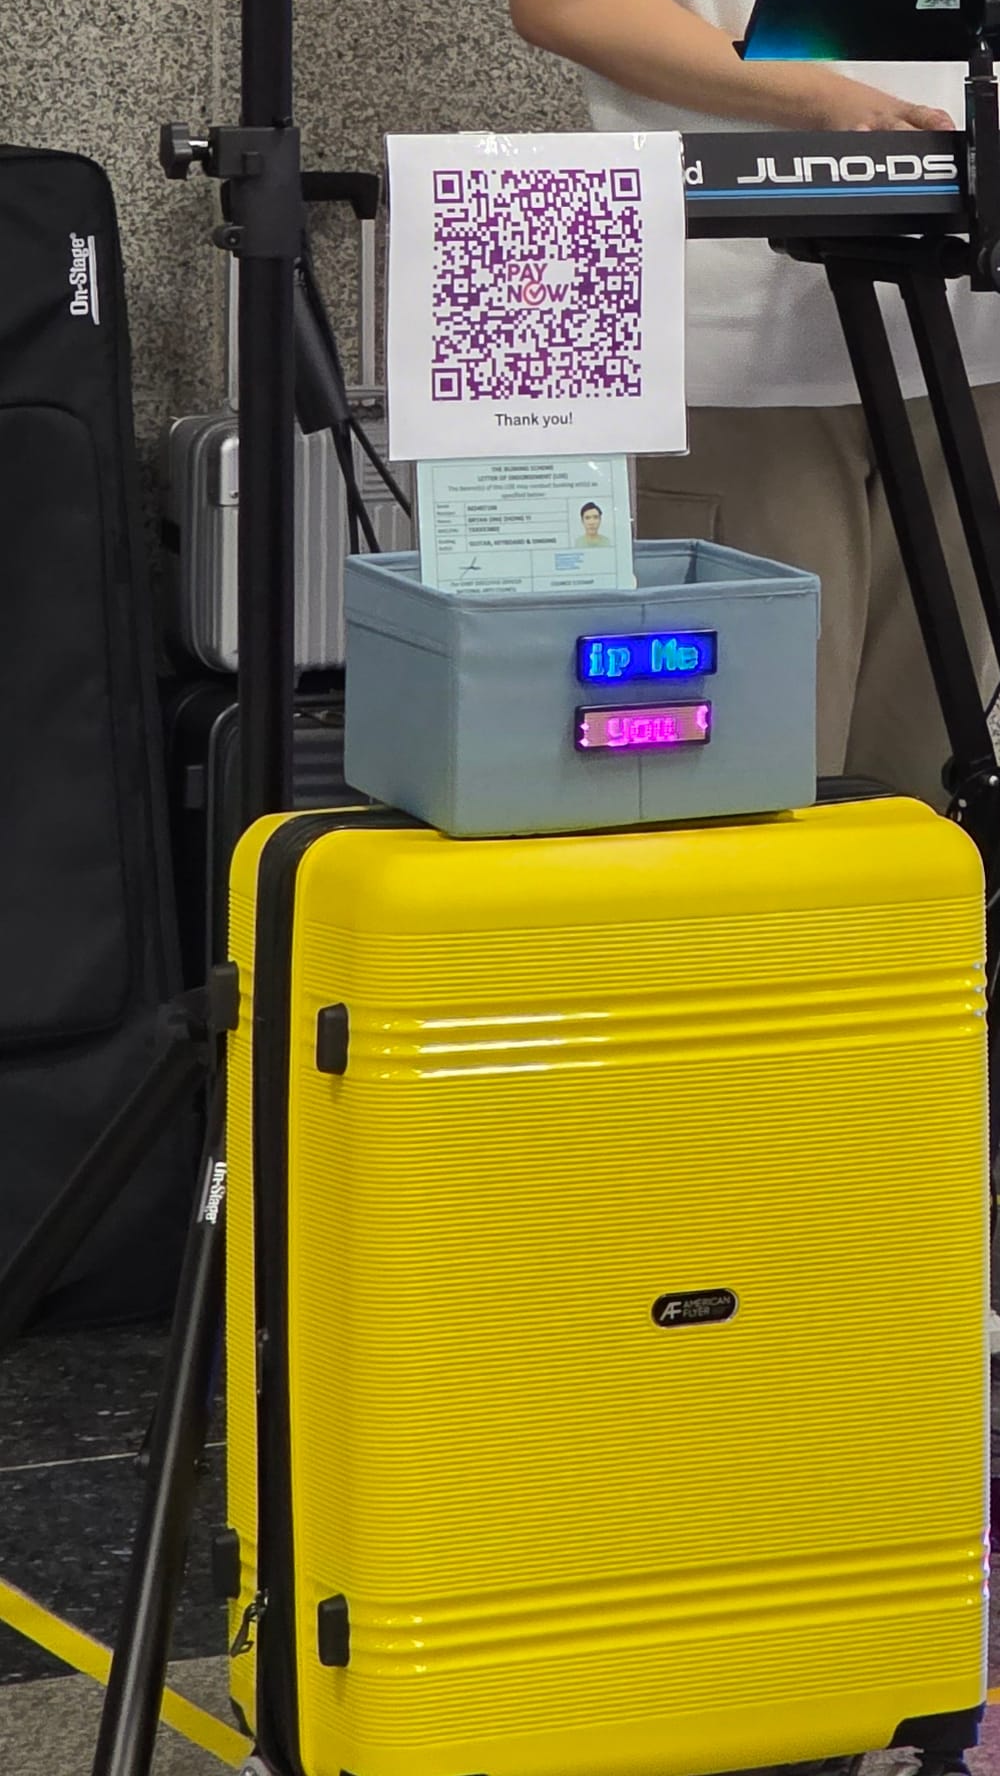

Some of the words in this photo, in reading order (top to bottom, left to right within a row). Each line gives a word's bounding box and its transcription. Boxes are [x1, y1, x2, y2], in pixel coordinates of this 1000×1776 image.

[737, 154, 958, 184] JUNO-DS
[69, 237, 89, 315] On-Stage
[508, 263, 548, 282] PAY
[507, 280, 569, 305] NOW
[494, 412, 539, 426] Thank
[542, 411, 573, 428] you!
[651, 638, 699, 672] Me
[682, 1296, 731, 1308] AMERICAN
